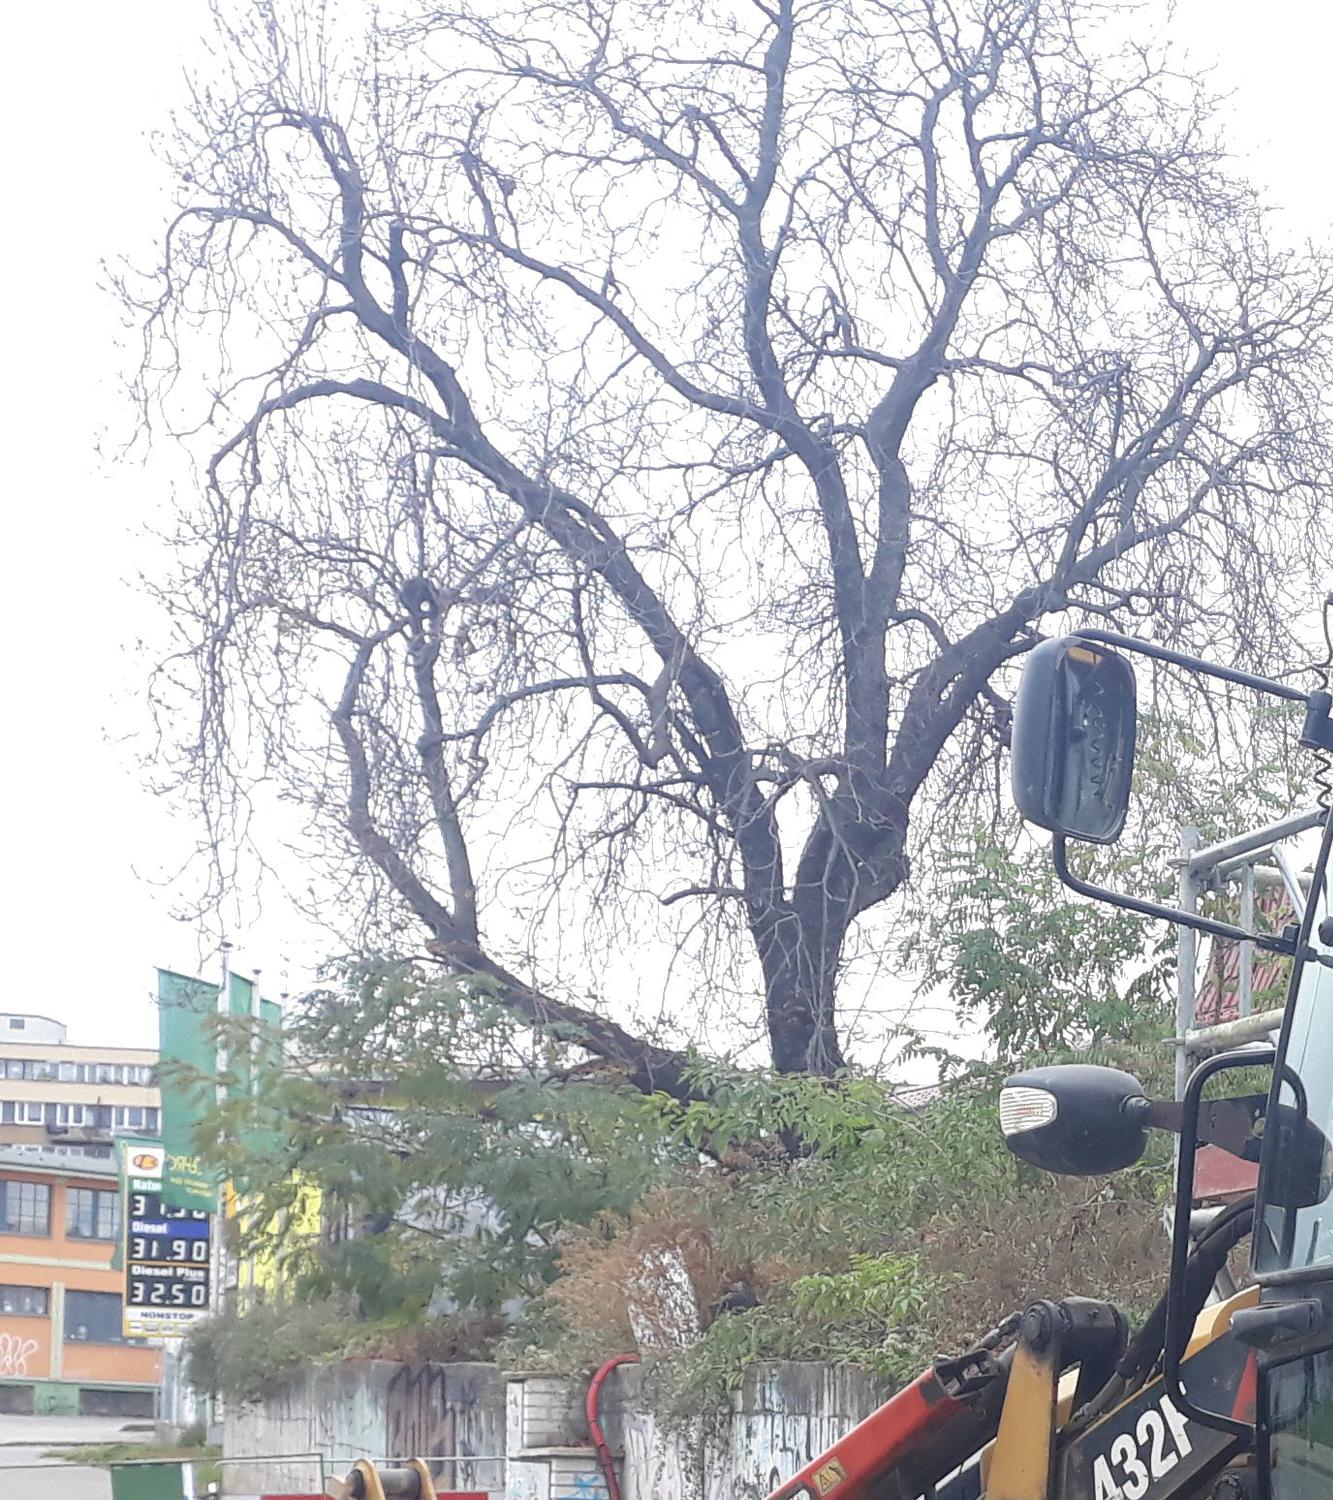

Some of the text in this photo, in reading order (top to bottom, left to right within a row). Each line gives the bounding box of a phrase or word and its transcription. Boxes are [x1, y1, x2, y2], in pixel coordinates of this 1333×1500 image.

[132, 1221, 168, 1235] Diesel
[132, 1238, 207, 1261] 31.90
[131, 1265, 205, 1278] Diesel Plus
[131, 1282, 205, 1305] 32.50
[141, 1311, 195, 1320] NONSTOP
